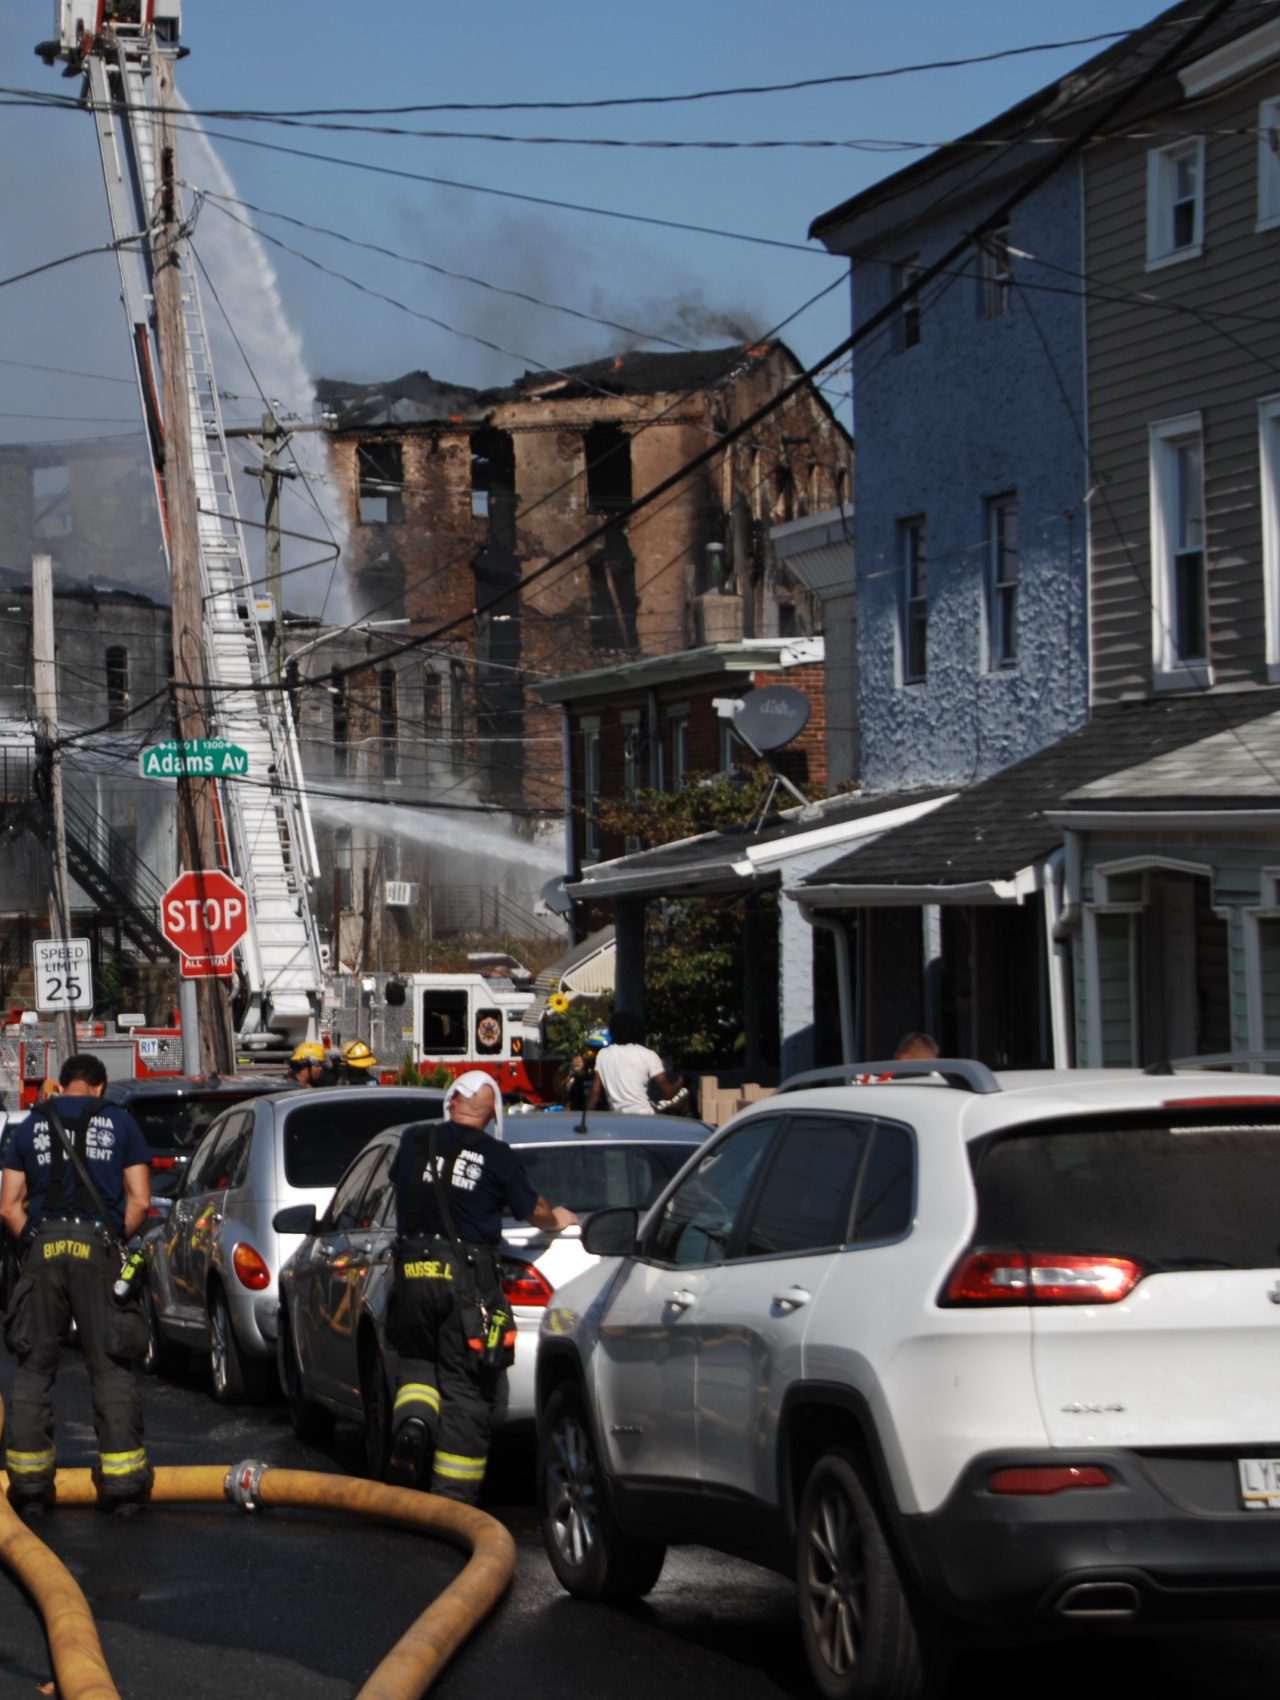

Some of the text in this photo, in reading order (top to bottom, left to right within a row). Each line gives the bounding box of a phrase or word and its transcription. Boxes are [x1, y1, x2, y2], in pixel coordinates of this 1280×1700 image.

[760, 698, 789, 714] dish
[203, 741, 224, 749] 1300
[146, 752, 244, 773] Adams Av
[167, 898, 242, 933] STOP
[40, 947, 84, 959] SPEED
[45, 961, 80, 973] LIMIT
[185, 959, 202, 968] ALL
[46, 976, 82, 1001] 25
[141, 1040, 158, 1054] RIT
[43, 1240, 91, 1259] BURTON
